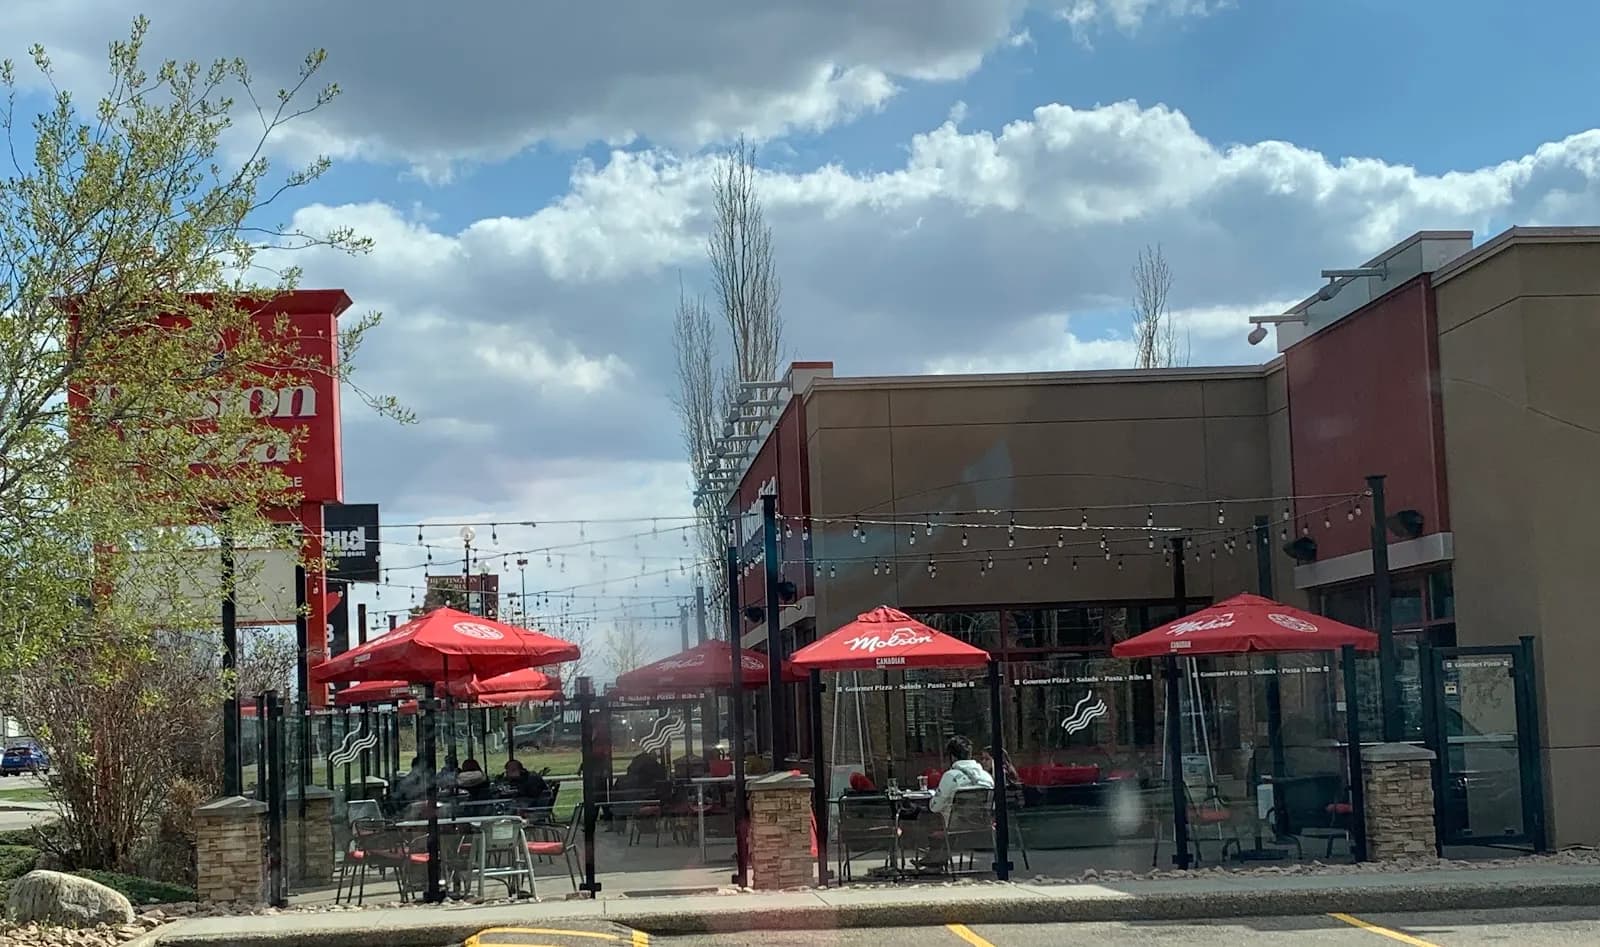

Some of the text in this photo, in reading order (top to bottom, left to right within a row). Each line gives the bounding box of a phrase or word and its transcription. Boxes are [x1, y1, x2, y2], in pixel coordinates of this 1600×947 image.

[843, 634, 934, 653] Molson
[876, 656, 906, 666] CANADIAN
[845, 685, 874, 693] Gourmet
[875, 684, 893, 692] Pizza
[563, 709, 583, 724] NOW
